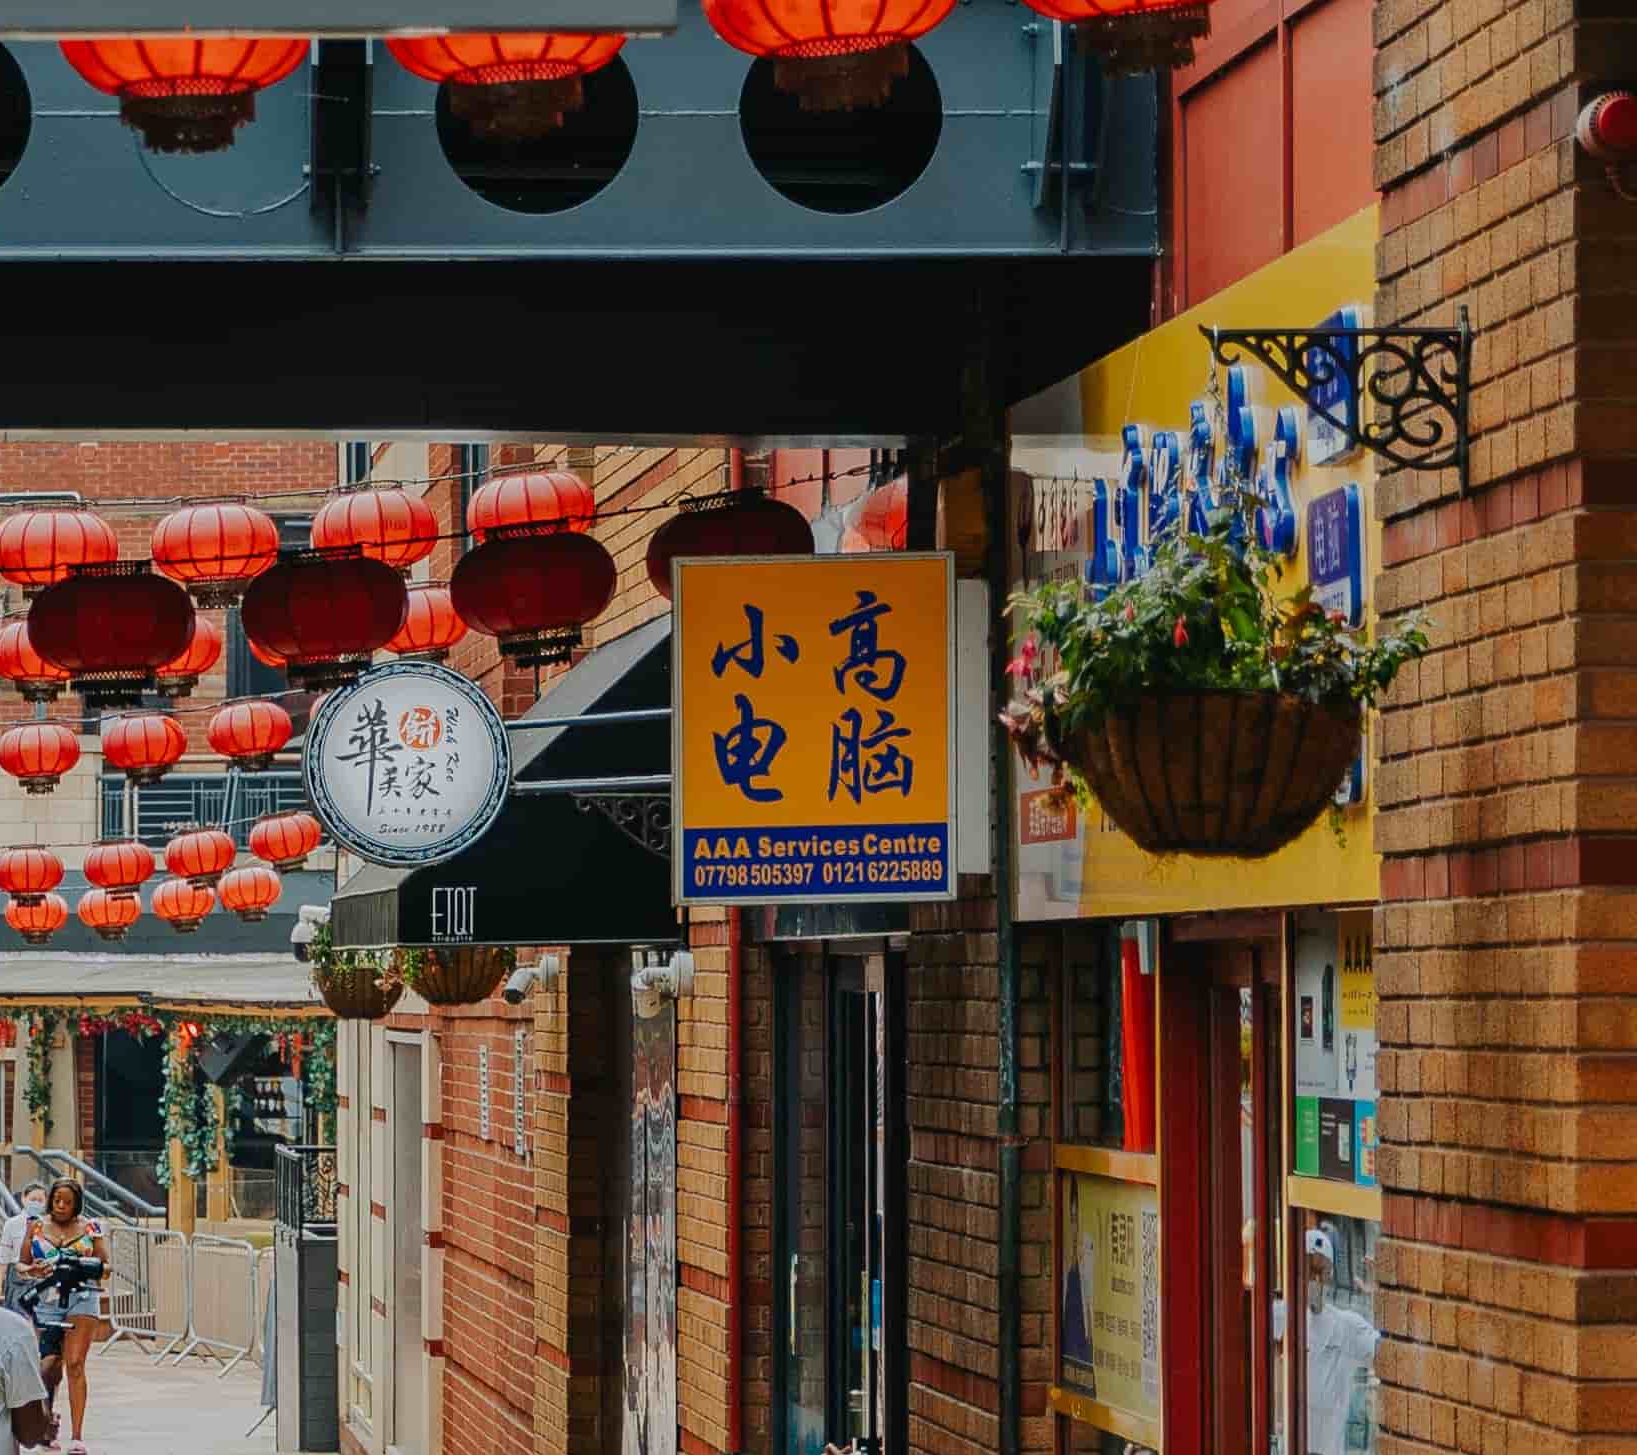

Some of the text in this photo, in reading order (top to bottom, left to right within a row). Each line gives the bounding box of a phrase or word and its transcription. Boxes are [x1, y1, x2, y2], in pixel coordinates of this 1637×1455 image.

[693, 833, 942, 859] AAA Services Centre
